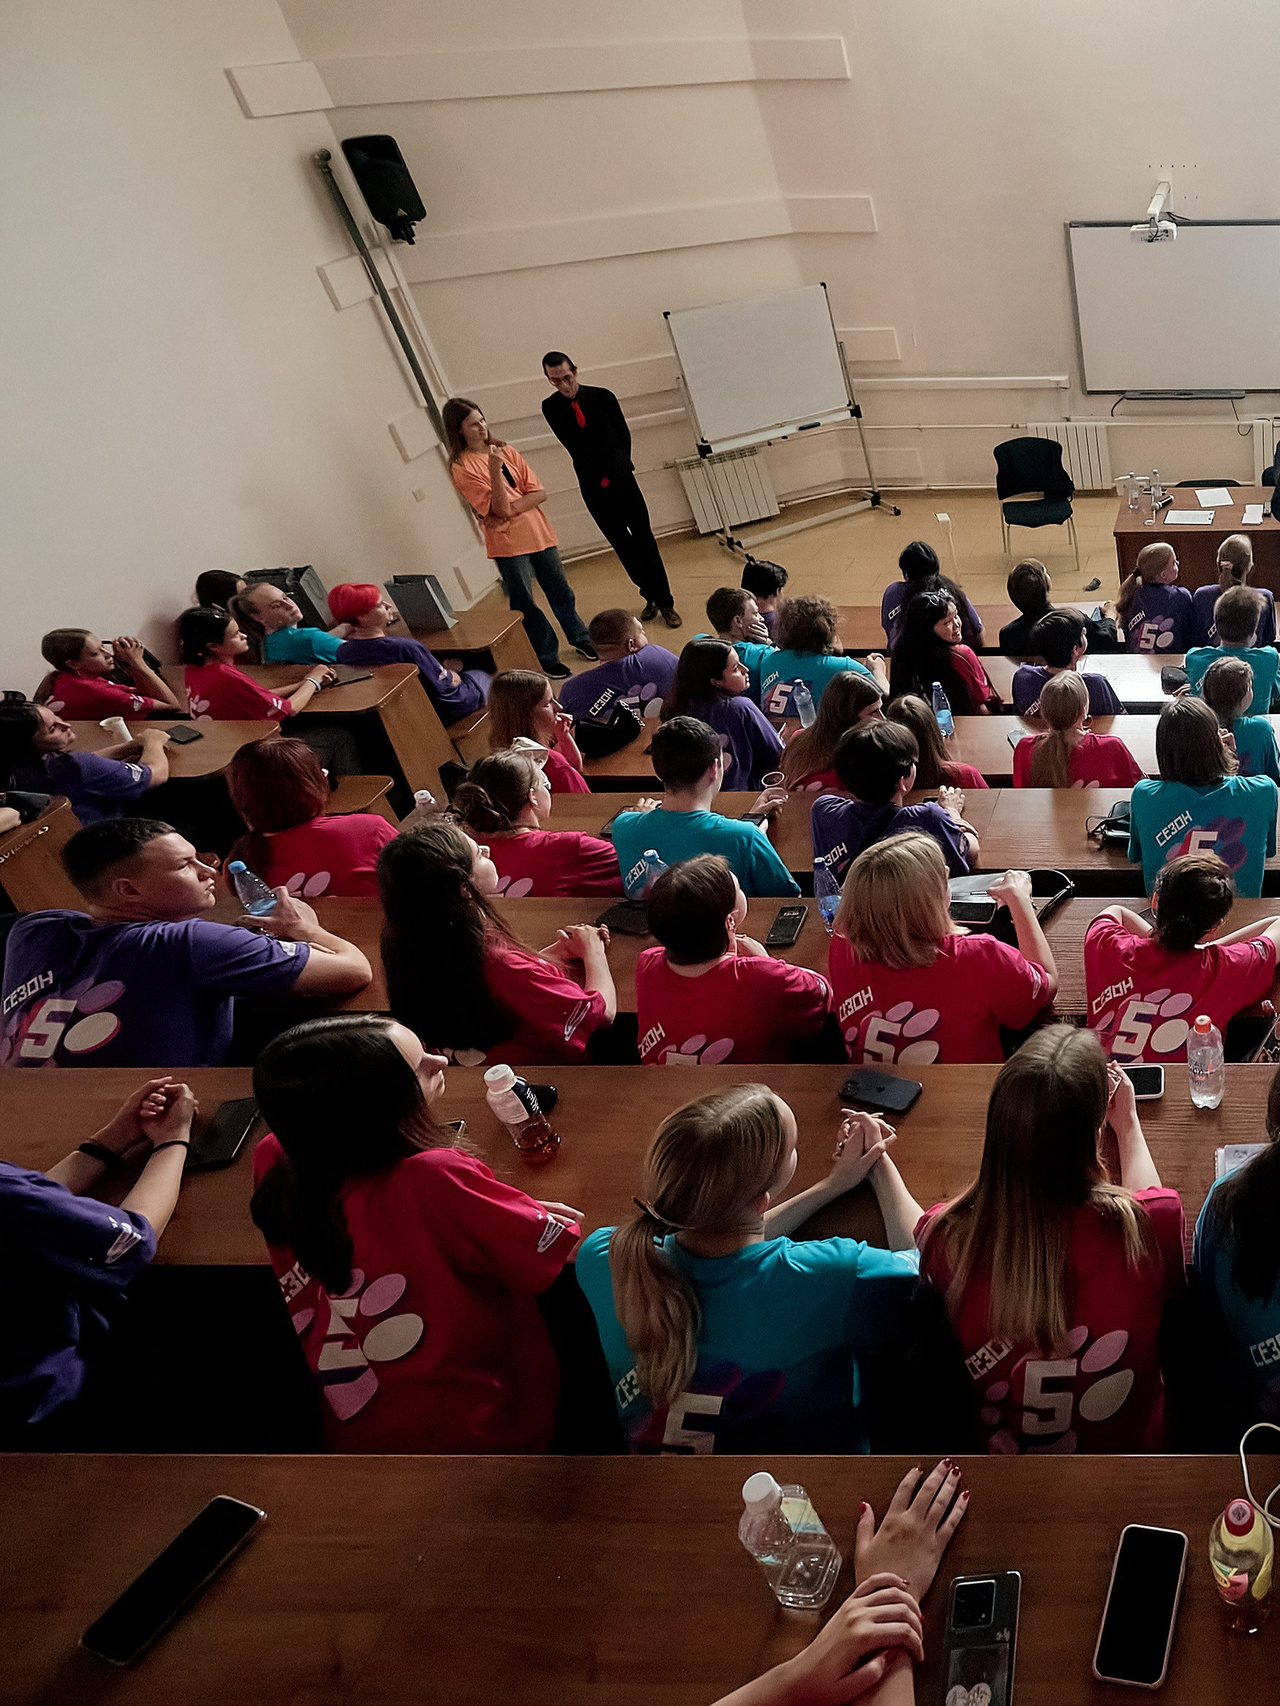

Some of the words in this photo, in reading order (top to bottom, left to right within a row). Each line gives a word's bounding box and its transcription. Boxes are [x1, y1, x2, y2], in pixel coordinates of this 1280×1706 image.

[1139, 623, 1159, 650] 5
[589, 688, 615, 717] СЕЗОН
[770, 683, 794, 714] 5
[1155, 810, 1193, 847] СЕЗОН
[825, 842, 848, 866] ЗОН
[1, 970, 54, 1015] СЕЗОН
[20, 998, 78, 1059] 5
[863, 1016, 902, 1065] 5
[1111, 1000, 1160, 1056] 5
[964, 1335, 1013, 1380] СЕЗО
[614, 1365, 641, 1410] СЕЗ
[1021, 1359, 1077, 1435] 5
[660, 1392, 724, 1455] 5
